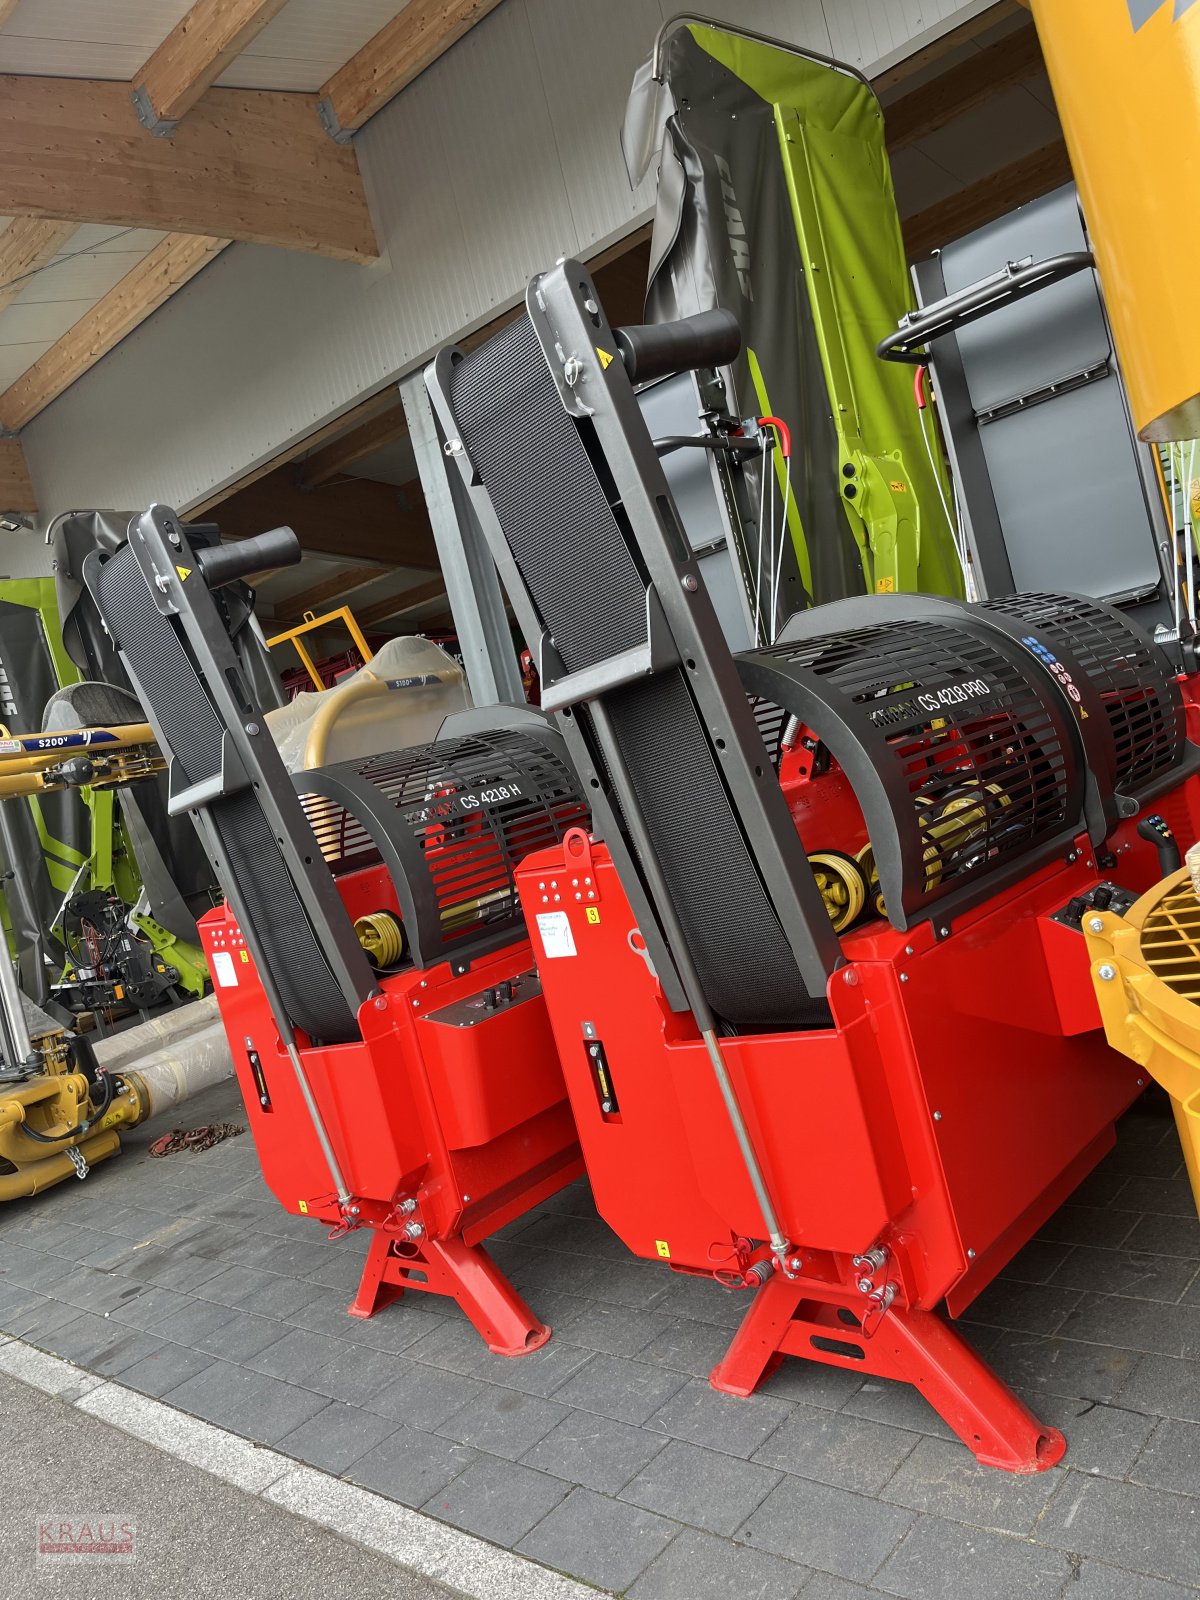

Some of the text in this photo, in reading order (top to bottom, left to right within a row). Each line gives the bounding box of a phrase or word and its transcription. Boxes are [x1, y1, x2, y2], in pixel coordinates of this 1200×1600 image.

[917, 693, 941, 712] CS
[936, 685, 969, 706] 4218
[961, 679, 991, 698] PRO
[460, 794, 480, 809] CS
[480, 786, 511, 803] 4218
[508, 783, 522, 796] H
